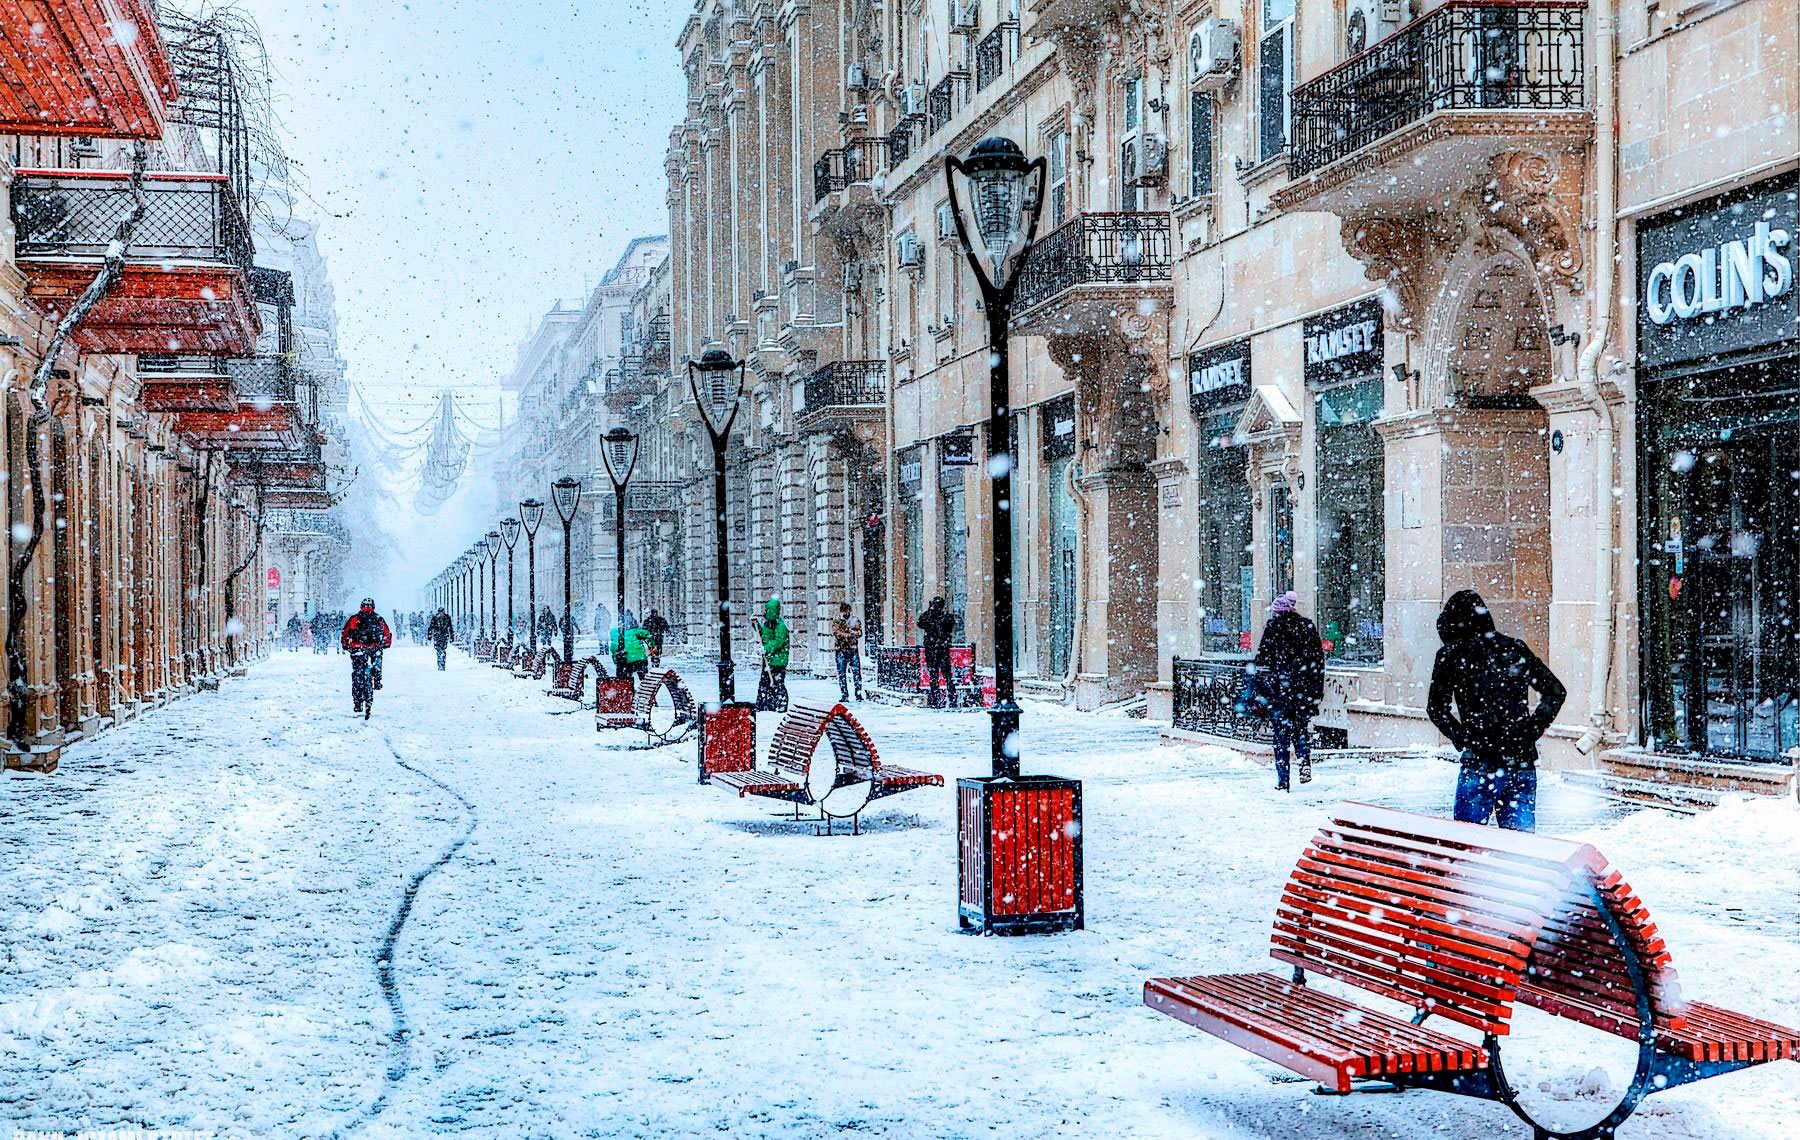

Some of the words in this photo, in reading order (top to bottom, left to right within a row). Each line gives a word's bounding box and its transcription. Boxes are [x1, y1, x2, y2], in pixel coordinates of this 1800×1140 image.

[1647, 221, 1793, 324] COLIN'S
[1307, 320, 1376, 364] RAMSEY
[1191, 358, 1244, 395] RAMSEY
